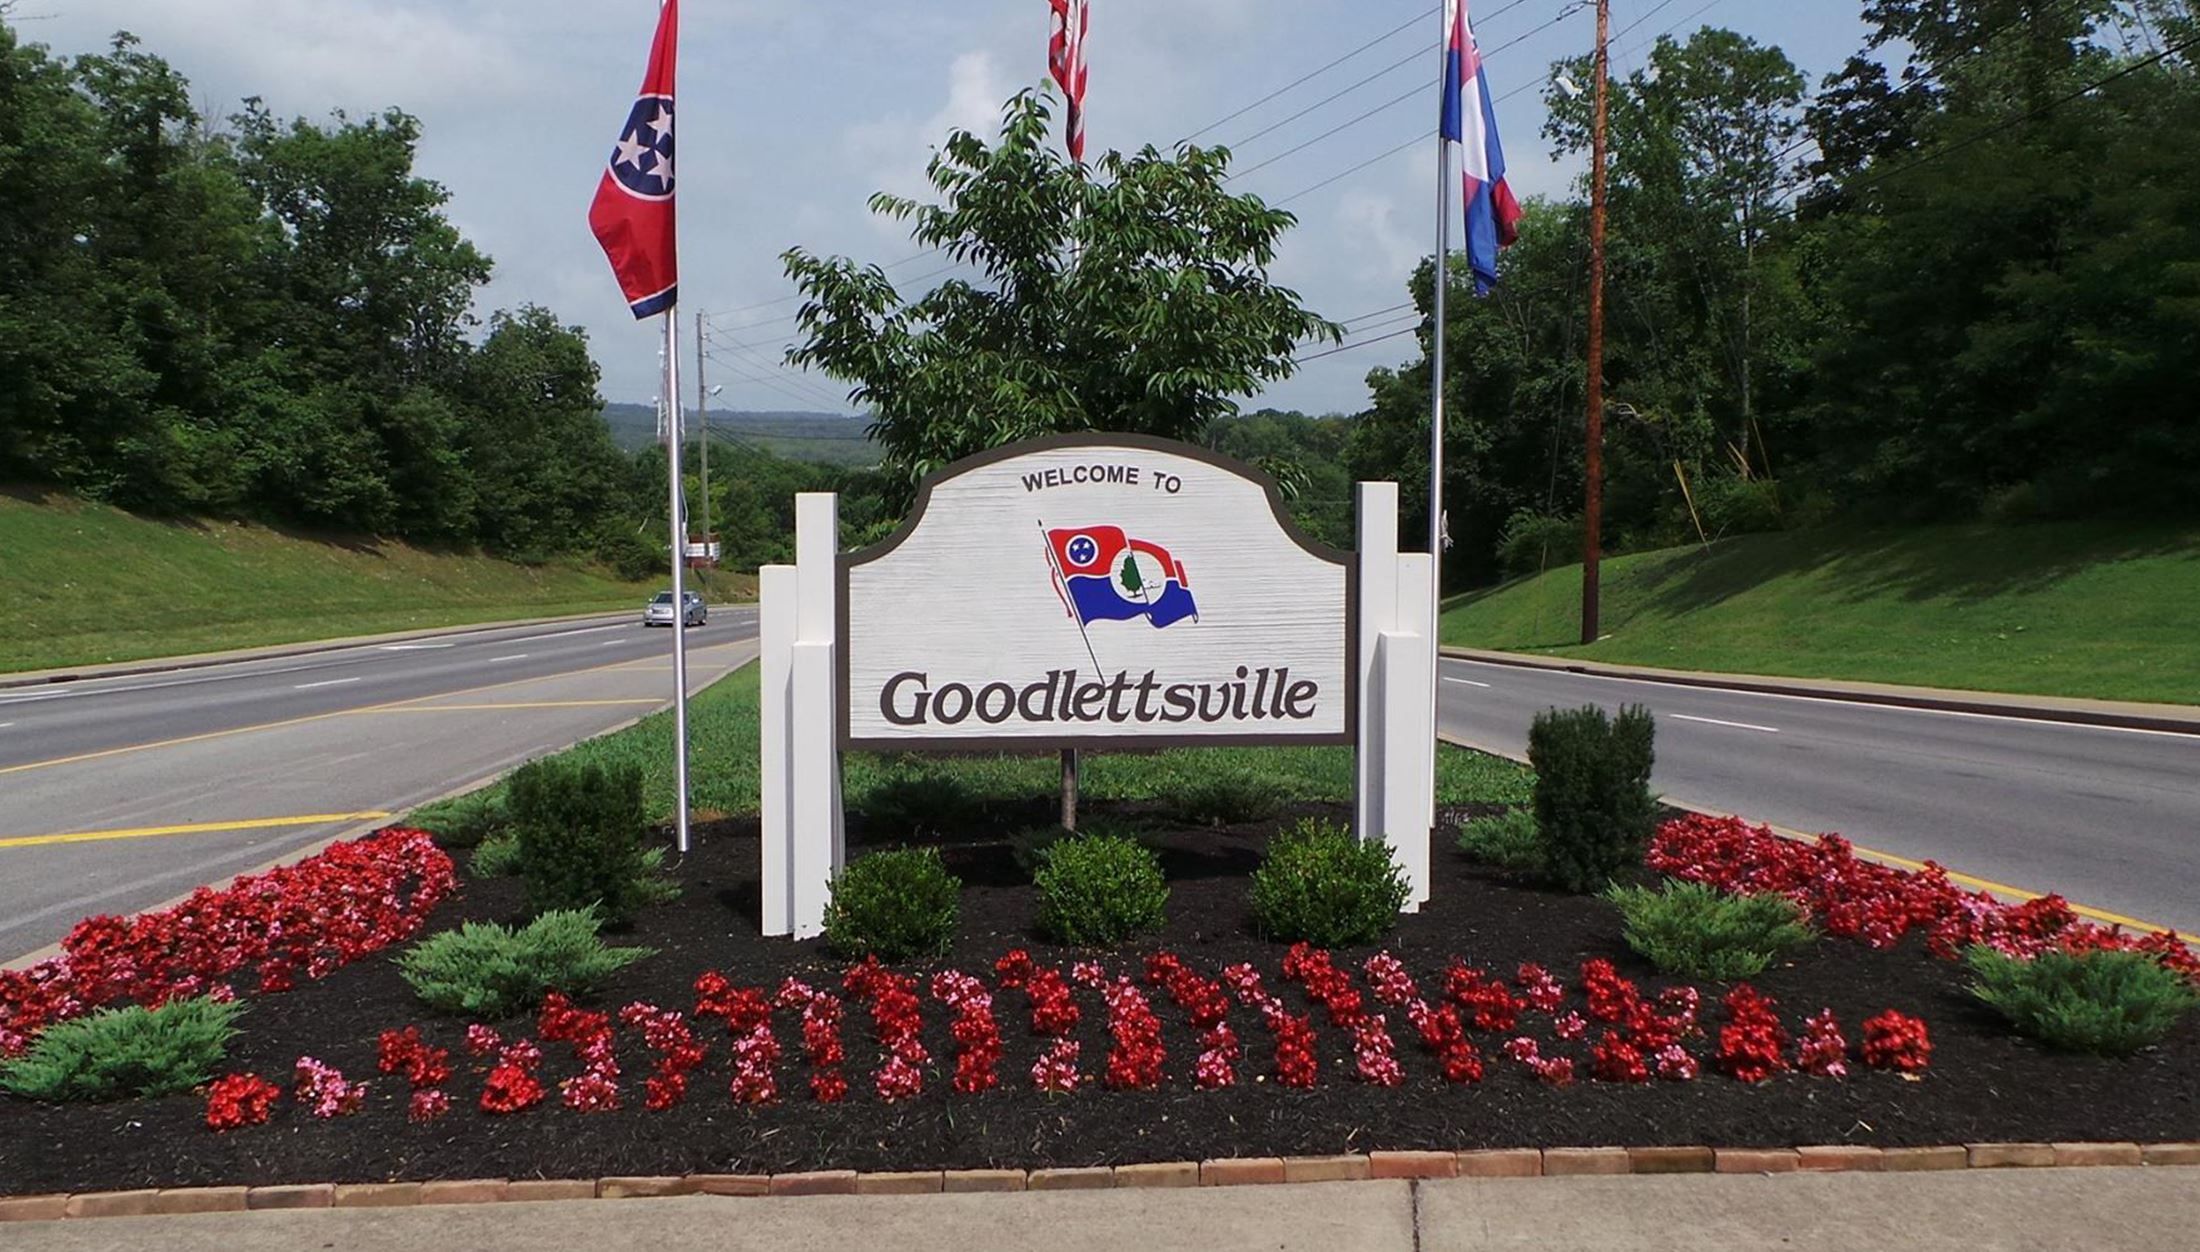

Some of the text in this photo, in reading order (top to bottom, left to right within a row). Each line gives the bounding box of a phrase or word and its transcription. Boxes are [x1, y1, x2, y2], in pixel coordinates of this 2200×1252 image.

[1022, 464, 1182, 494] WELCOME TO
[880, 665, 1318, 726] Goodlettsville
